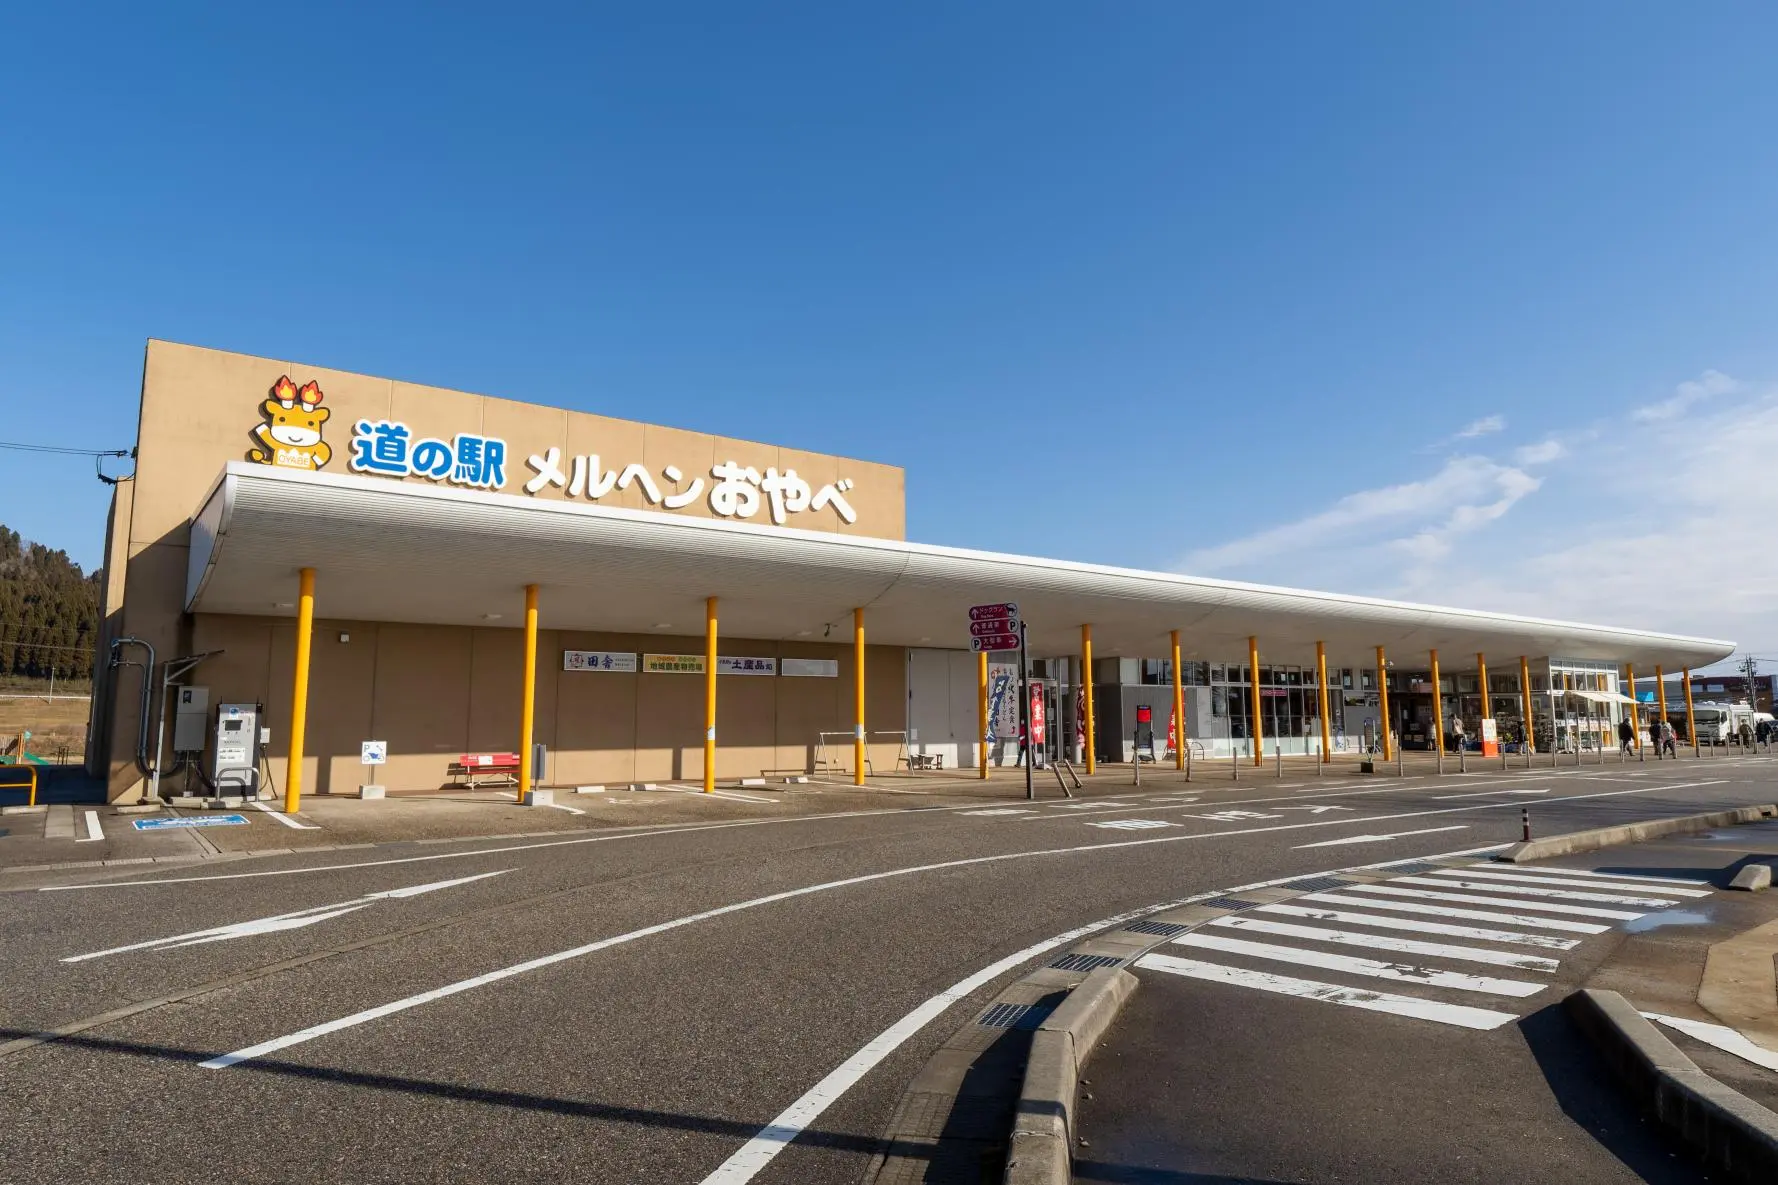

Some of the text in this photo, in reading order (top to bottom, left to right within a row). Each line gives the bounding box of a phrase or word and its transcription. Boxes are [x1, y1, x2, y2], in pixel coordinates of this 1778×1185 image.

[279, 454, 309, 465] OYABE
[352, 418, 507, 488] 道の駅
